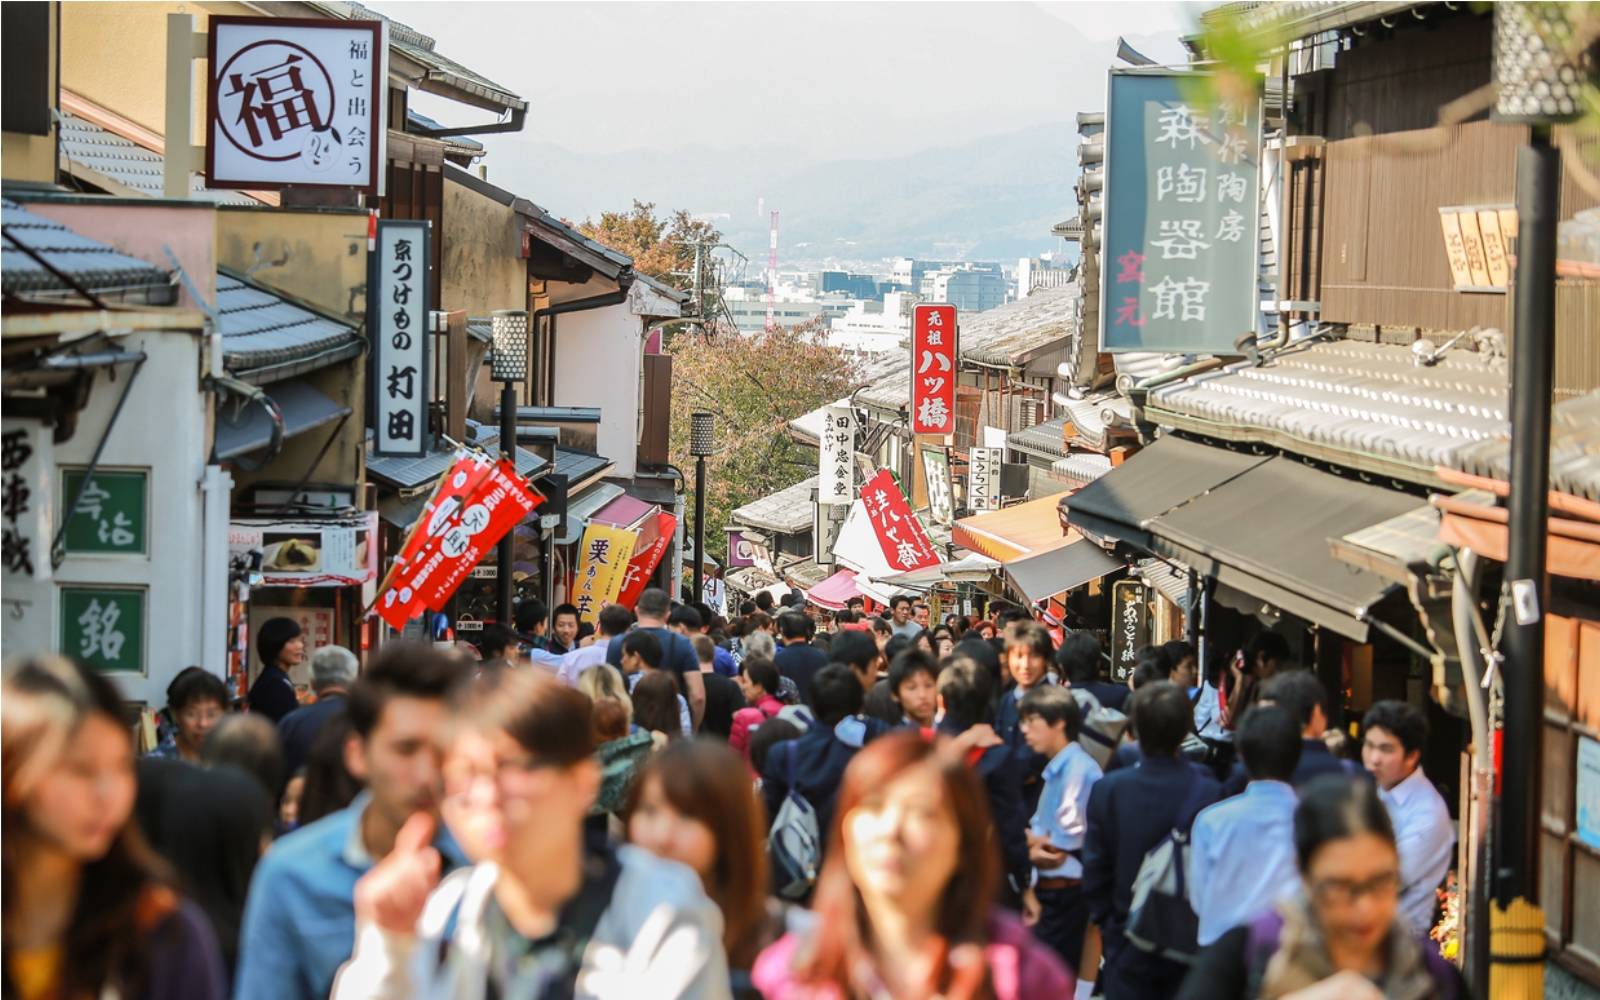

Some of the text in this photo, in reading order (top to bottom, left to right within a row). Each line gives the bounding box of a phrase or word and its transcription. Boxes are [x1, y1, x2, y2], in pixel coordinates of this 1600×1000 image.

[224, 54, 323, 148] 福
[346, 39, 370, 176] 福と出会う
[1148, 105, 1212, 322] 森陶器館
[387, 239, 418, 441] 京つけもの 打田
[928, 311, 943, 345] 元祖
[78, 599, 126, 659] 銘
